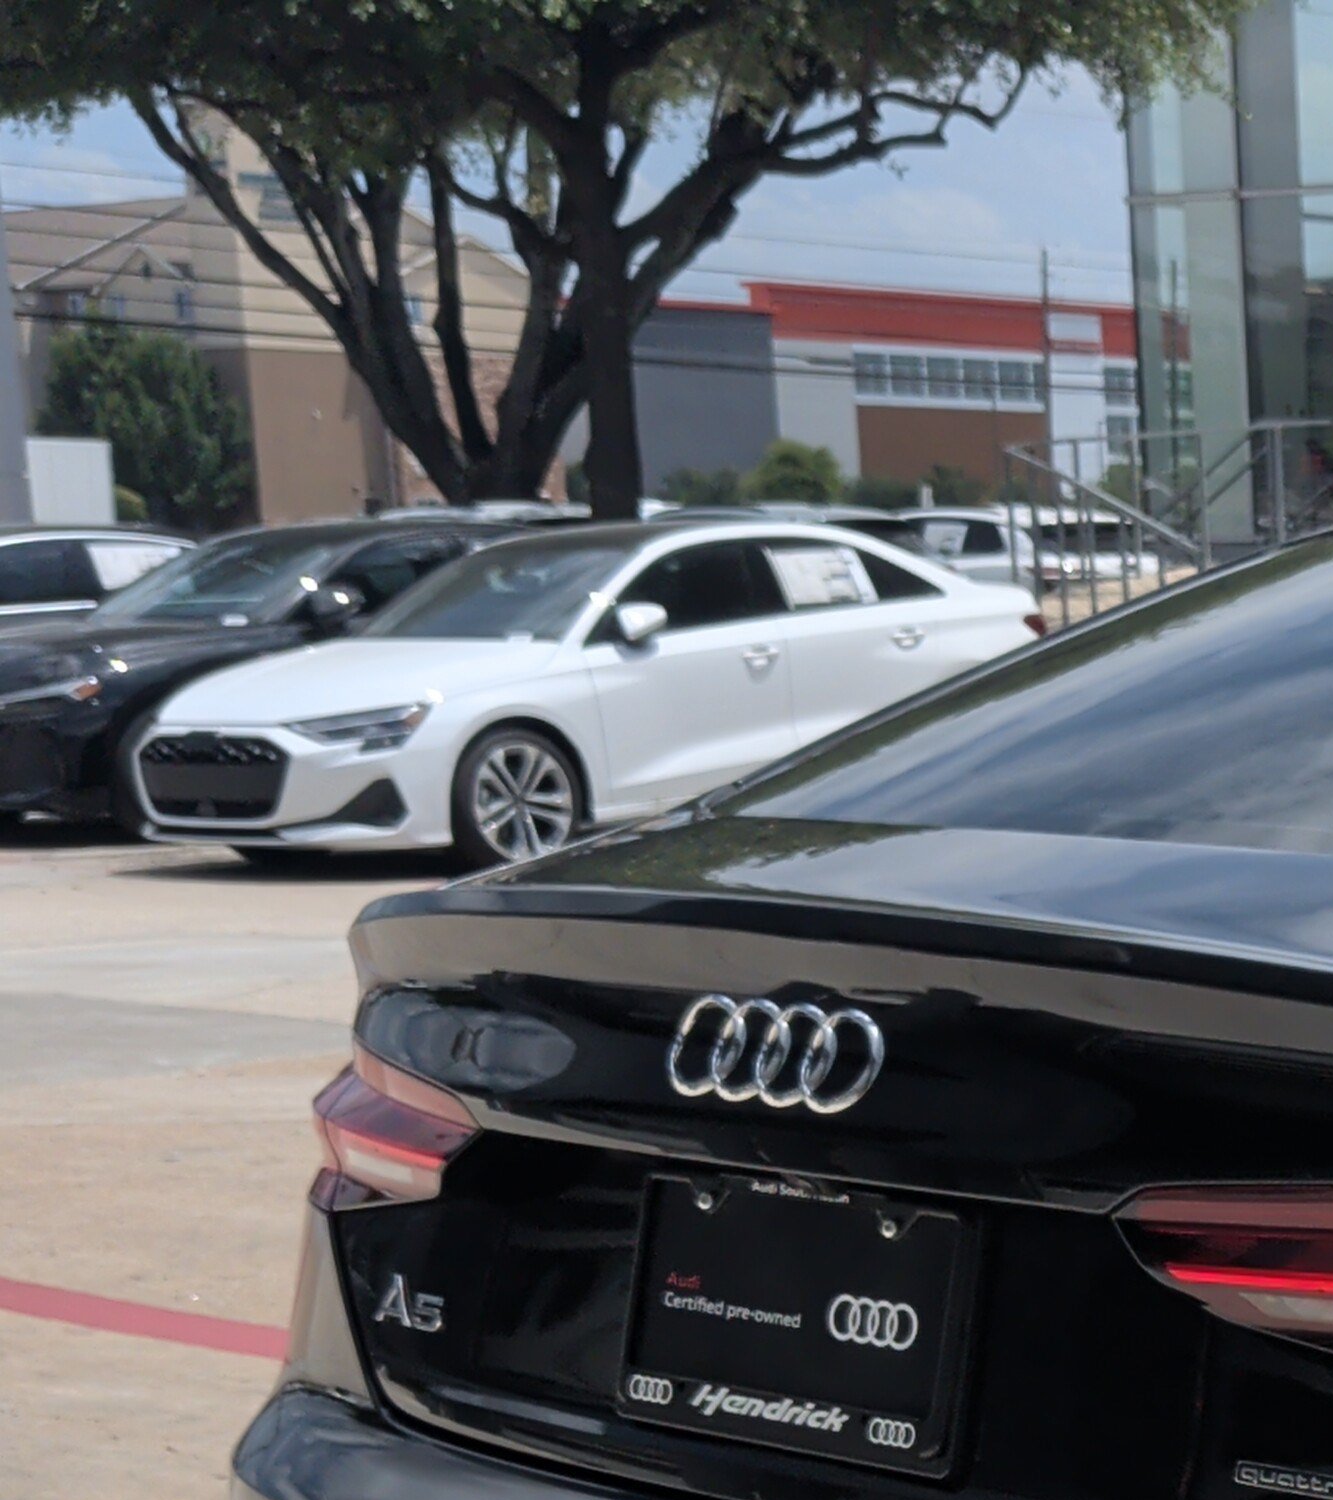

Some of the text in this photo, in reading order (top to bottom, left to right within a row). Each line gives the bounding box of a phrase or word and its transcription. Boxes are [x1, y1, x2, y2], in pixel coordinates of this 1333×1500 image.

[666, 1272, 700, 1288] Audi
[375, 1273, 444, 1332] A5
[664, 1291, 802, 1328] Certified pre-owned
[690, 1384, 850, 1432] Hendrick
